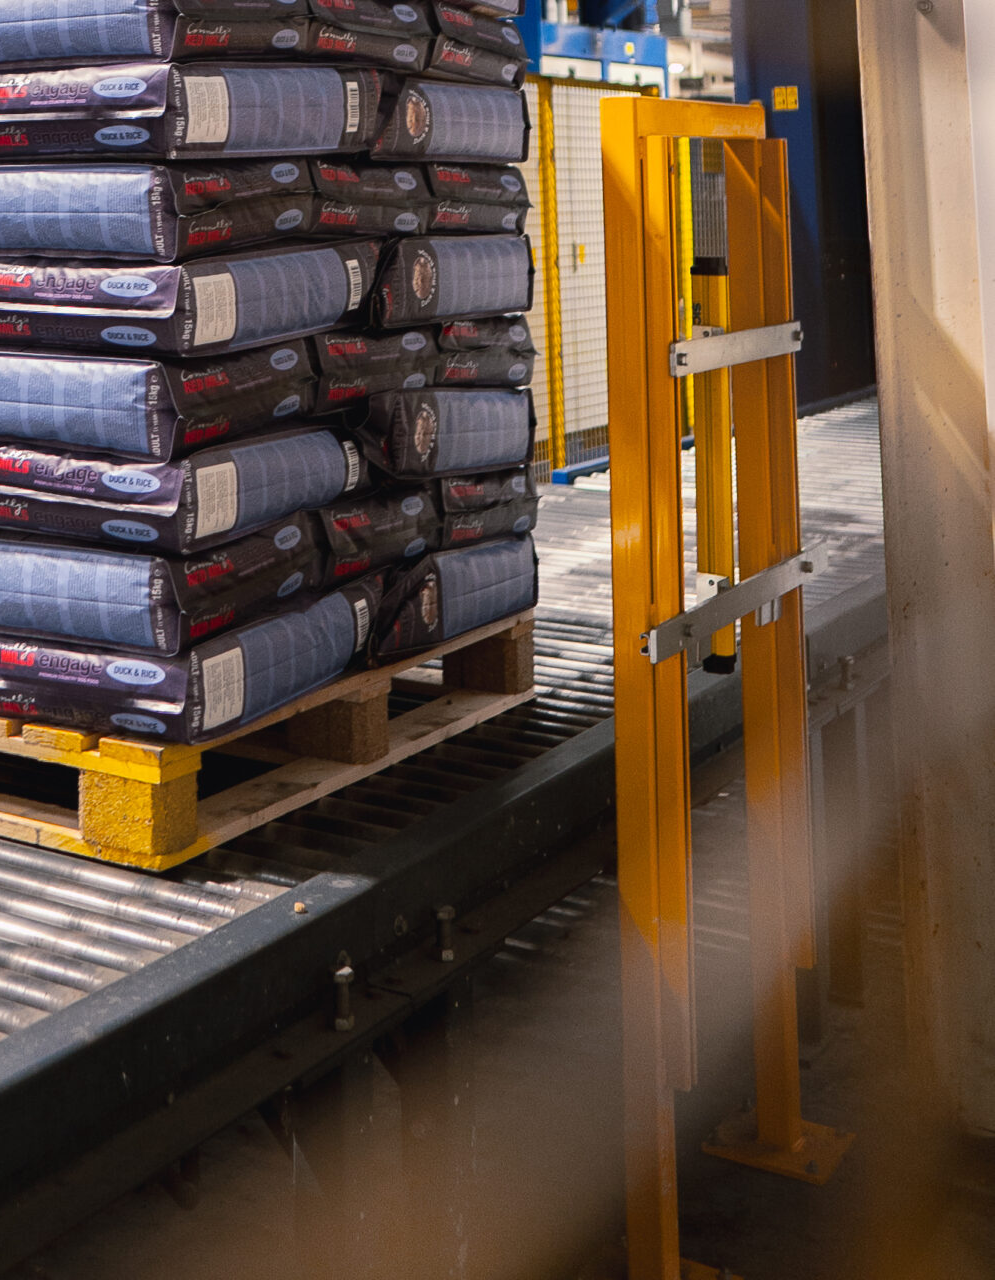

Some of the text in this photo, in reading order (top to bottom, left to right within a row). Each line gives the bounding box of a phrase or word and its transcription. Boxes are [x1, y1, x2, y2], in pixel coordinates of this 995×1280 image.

[185, 35, 204, 46] RED
[187, 23, 233, 42] Connolly's
[30, 82, 90, 98] engage
[175, 116, 184, 142] 15kg
[151, 185, 162, 206] 15kg
[185, 182, 205, 195] RED
[188, 220, 234, 236] Connolly's
[36, 272, 97, 291] engage
[108, 282, 125, 290] DUCK
[134, 282, 150, 291] RICE
[108, 332, 125, 340] DUCK
[134, 333, 150, 341] RICE
[182, 320, 192, 341] 15kg
[148, 383, 160, 406] 15kg
[34, 461, 100, 482] engage
[109, 475, 127, 483] DUCK
[135, 478, 153, 488] RICE
[109, 524, 127, 533] DUCK
[135, 528, 152, 538] RICE
[185, 512, 194, 534] 15kg
[152, 578, 163, 600] 15kg
[1, 650, 36, 667] MILLS
[39, 654, 103, 675] engage
[114, 666, 133, 675] DUCK
[142, 669, 160, 678] RICE
[192, 705, 201, 728] 15kg
